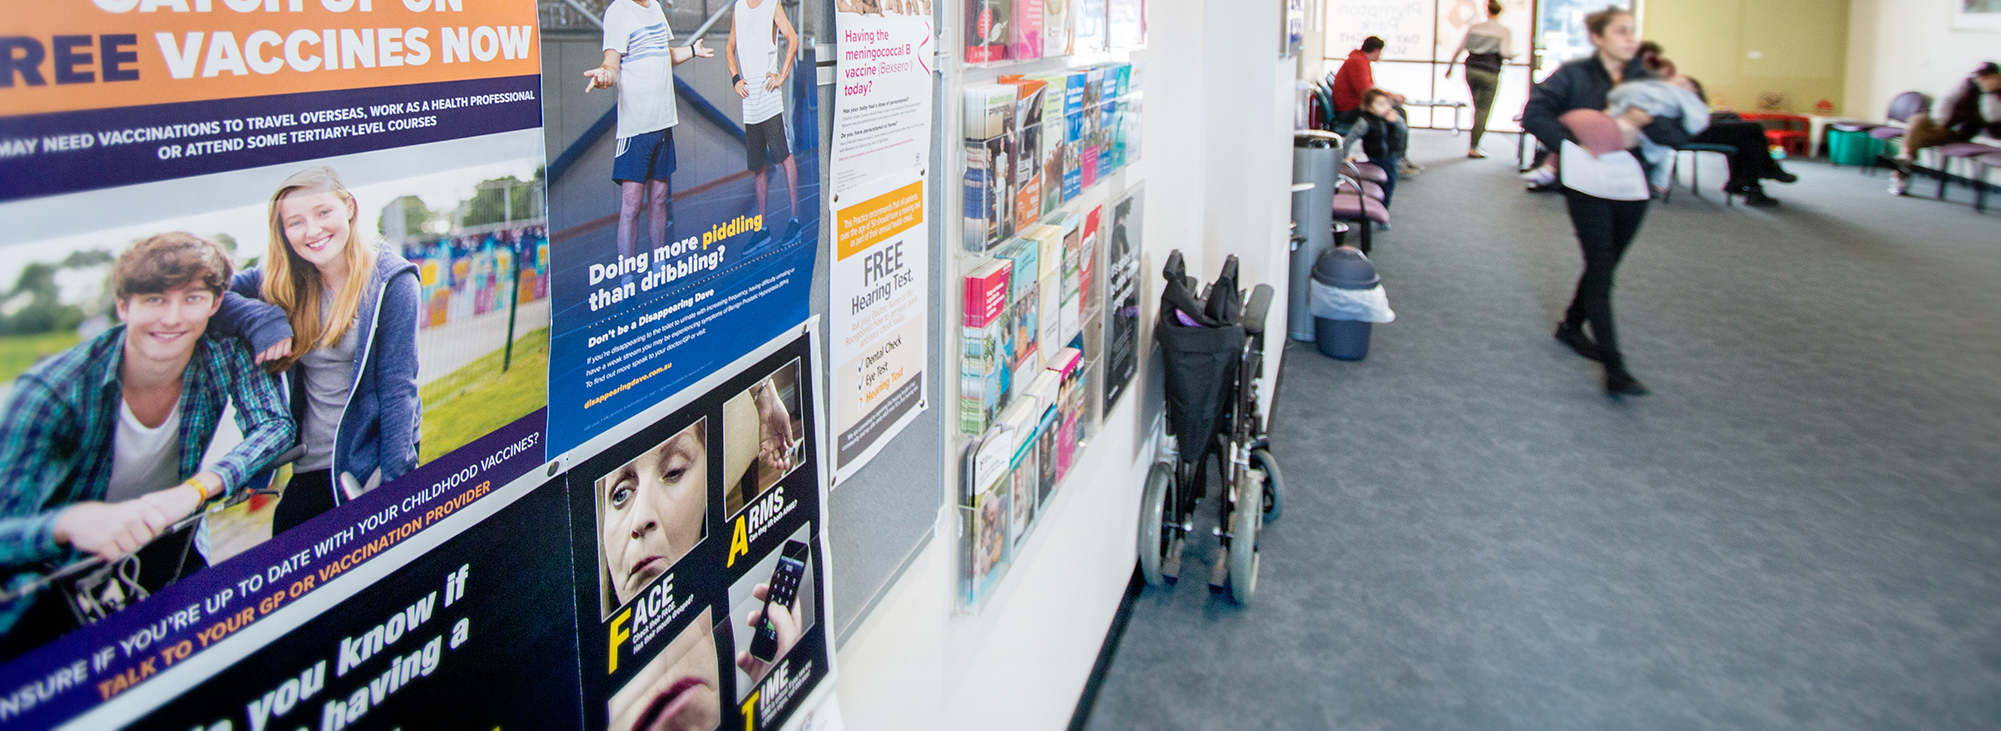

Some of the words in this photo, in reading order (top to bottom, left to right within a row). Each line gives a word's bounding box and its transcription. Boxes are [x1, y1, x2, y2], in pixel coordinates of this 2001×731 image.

[0, 34, 139, 88] REE
[154, 26, 431, 79] VACCINES
[440, 25, 532, 64] NOW
[845, 28, 874, 44] Having
[876, 28, 889, 40] the
[846, 44, 904, 61] meningococcal
[906, 43, 911, 55] B
[844, 80, 872, 96] today?
[845, 63, 876, 78] vaccine
[0, 137, 39, 158] MAY
[42, 133, 95, 153] NEED
[98, 120, 221, 146] VACCINATIONS
[223, 118, 244, 133] TO
[246, 111, 298, 130] TRAVEL
[299, 105, 368, 124] OVERSEAS,
[369, 102, 404, 117] WORK
[405, 101, 420, 113] AS
[421, 100, 430, 111] A
[431, 96, 469, 110] HEALTH
[470, 90, 535, 106] PROFESSIONAL
[157, 143, 182, 160] OR
[185, 137, 244, 157] ATTEND
[247, 132, 287, 149] SOME
[289, 122, 386, 144] TERTIARY-LEVEL
[387, 115, 437, 133] COURSES
[840, 231, 850, 241] over
[844, 218, 853, 229] This
[853, 213, 868, 225] Practice
[588, 252, 649, 286] Doing
[653, 236, 698, 263] more
[702, 214, 763, 250] piddling
[864, 240, 903, 287] FREE
[588, 281, 636, 312] than
[640, 244, 726, 292] dribbling?
[852, 281, 891, 316] Hearing
[893, 268, 913, 290] Test.
[587, 357, 592, 365] If
[592, 351, 611, 364] you're
[611, 335, 646, 354] disappearing
[653, 327, 661, 336] the
[661, 321, 674, 332] toilet
[674, 318, 680, 326] to
[680, 312, 696, 324] urinate
[697, 307, 706, 316] with
[706, 298, 728, 312] increasing
[588, 328, 615, 348] Don't
[617, 323, 629, 336] be
[630, 321, 637, 330] a
[638, 297, 694, 327] Disappearing
[694, 289, 714, 303] Dave
[585, 366, 601, 377] have
[607, 356, 622, 368] weak
[623, 348, 642, 360] stream
[642, 343, 652, 353] you
[653, 338, 664, 349] may
[664, 334, 671, 342] be
[671, 321, 701, 339] experiencing
[701, 310, 723, 325] symptoms
[593, 375, 606, 385] find
[606, 370, 616, 379] out
[616, 364, 631, 375] more
[632, 355, 648, 368] speak
[654, 347, 667, 359] your
[865, 345, 885, 368] Dental
[885, 335, 902, 354] Check
[584, 362, 672, 409] disappearingdave.com.au
[865, 372, 876, 386] Eye
[877, 362, 888, 377] Test
[865, 379, 890, 404] Hearing
[891, 367, 903, 383] Test
[727, 486, 784, 568] ARMS
[0, 659, 88, 724] NSURE
[92, 646, 116, 675] IF
[119, 603, 201, 658] YOU'RE
[204, 588, 233, 615] UP
[237, 574, 263, 598] TO
[267, 549, 311, 584] DATE
[313, 527, 354, 560] WITH
[357, 504, 398, 535] YOUR
[402, 463, 479, 513] CHILDHOOD
[480, 431, 540, 472] VACCINES?
[97, 656, 157, 701] TALK
[160, 639, 193, 667] TO
[196, 607, 255, 648] YOUR
[259, 590, 286, 615] GP
[289, 574, 315, 598] OR
[318, 516, 422, 583] VACCINATION
[425, 480, 491, 526] PROVIDER
[246, 659, 326, 731] you
[336, 590, 437, 677] know
[444, 563, 469, 608] if
[608, 572, 674, 675] FACE
[320, 634, 443, 731] having
[449, 617, 469, 649] a
